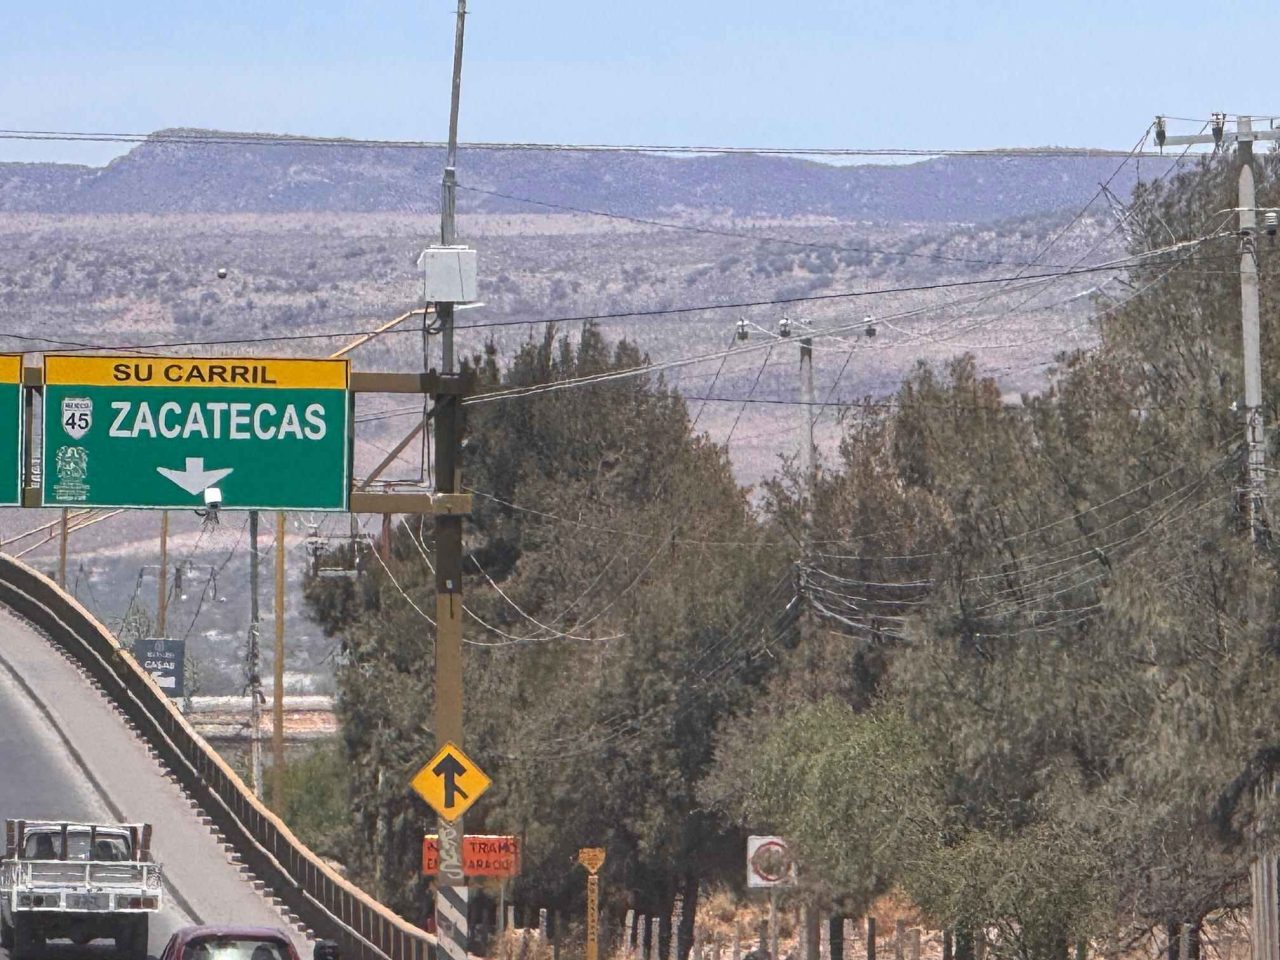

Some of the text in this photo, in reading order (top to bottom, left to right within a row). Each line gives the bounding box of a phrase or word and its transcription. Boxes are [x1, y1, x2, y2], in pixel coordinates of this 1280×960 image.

[113, 363, 277, 384] SU CARRIL
[64, 412, 90, 430] 45
[109, 401, 327, 441] ZACATECAS
